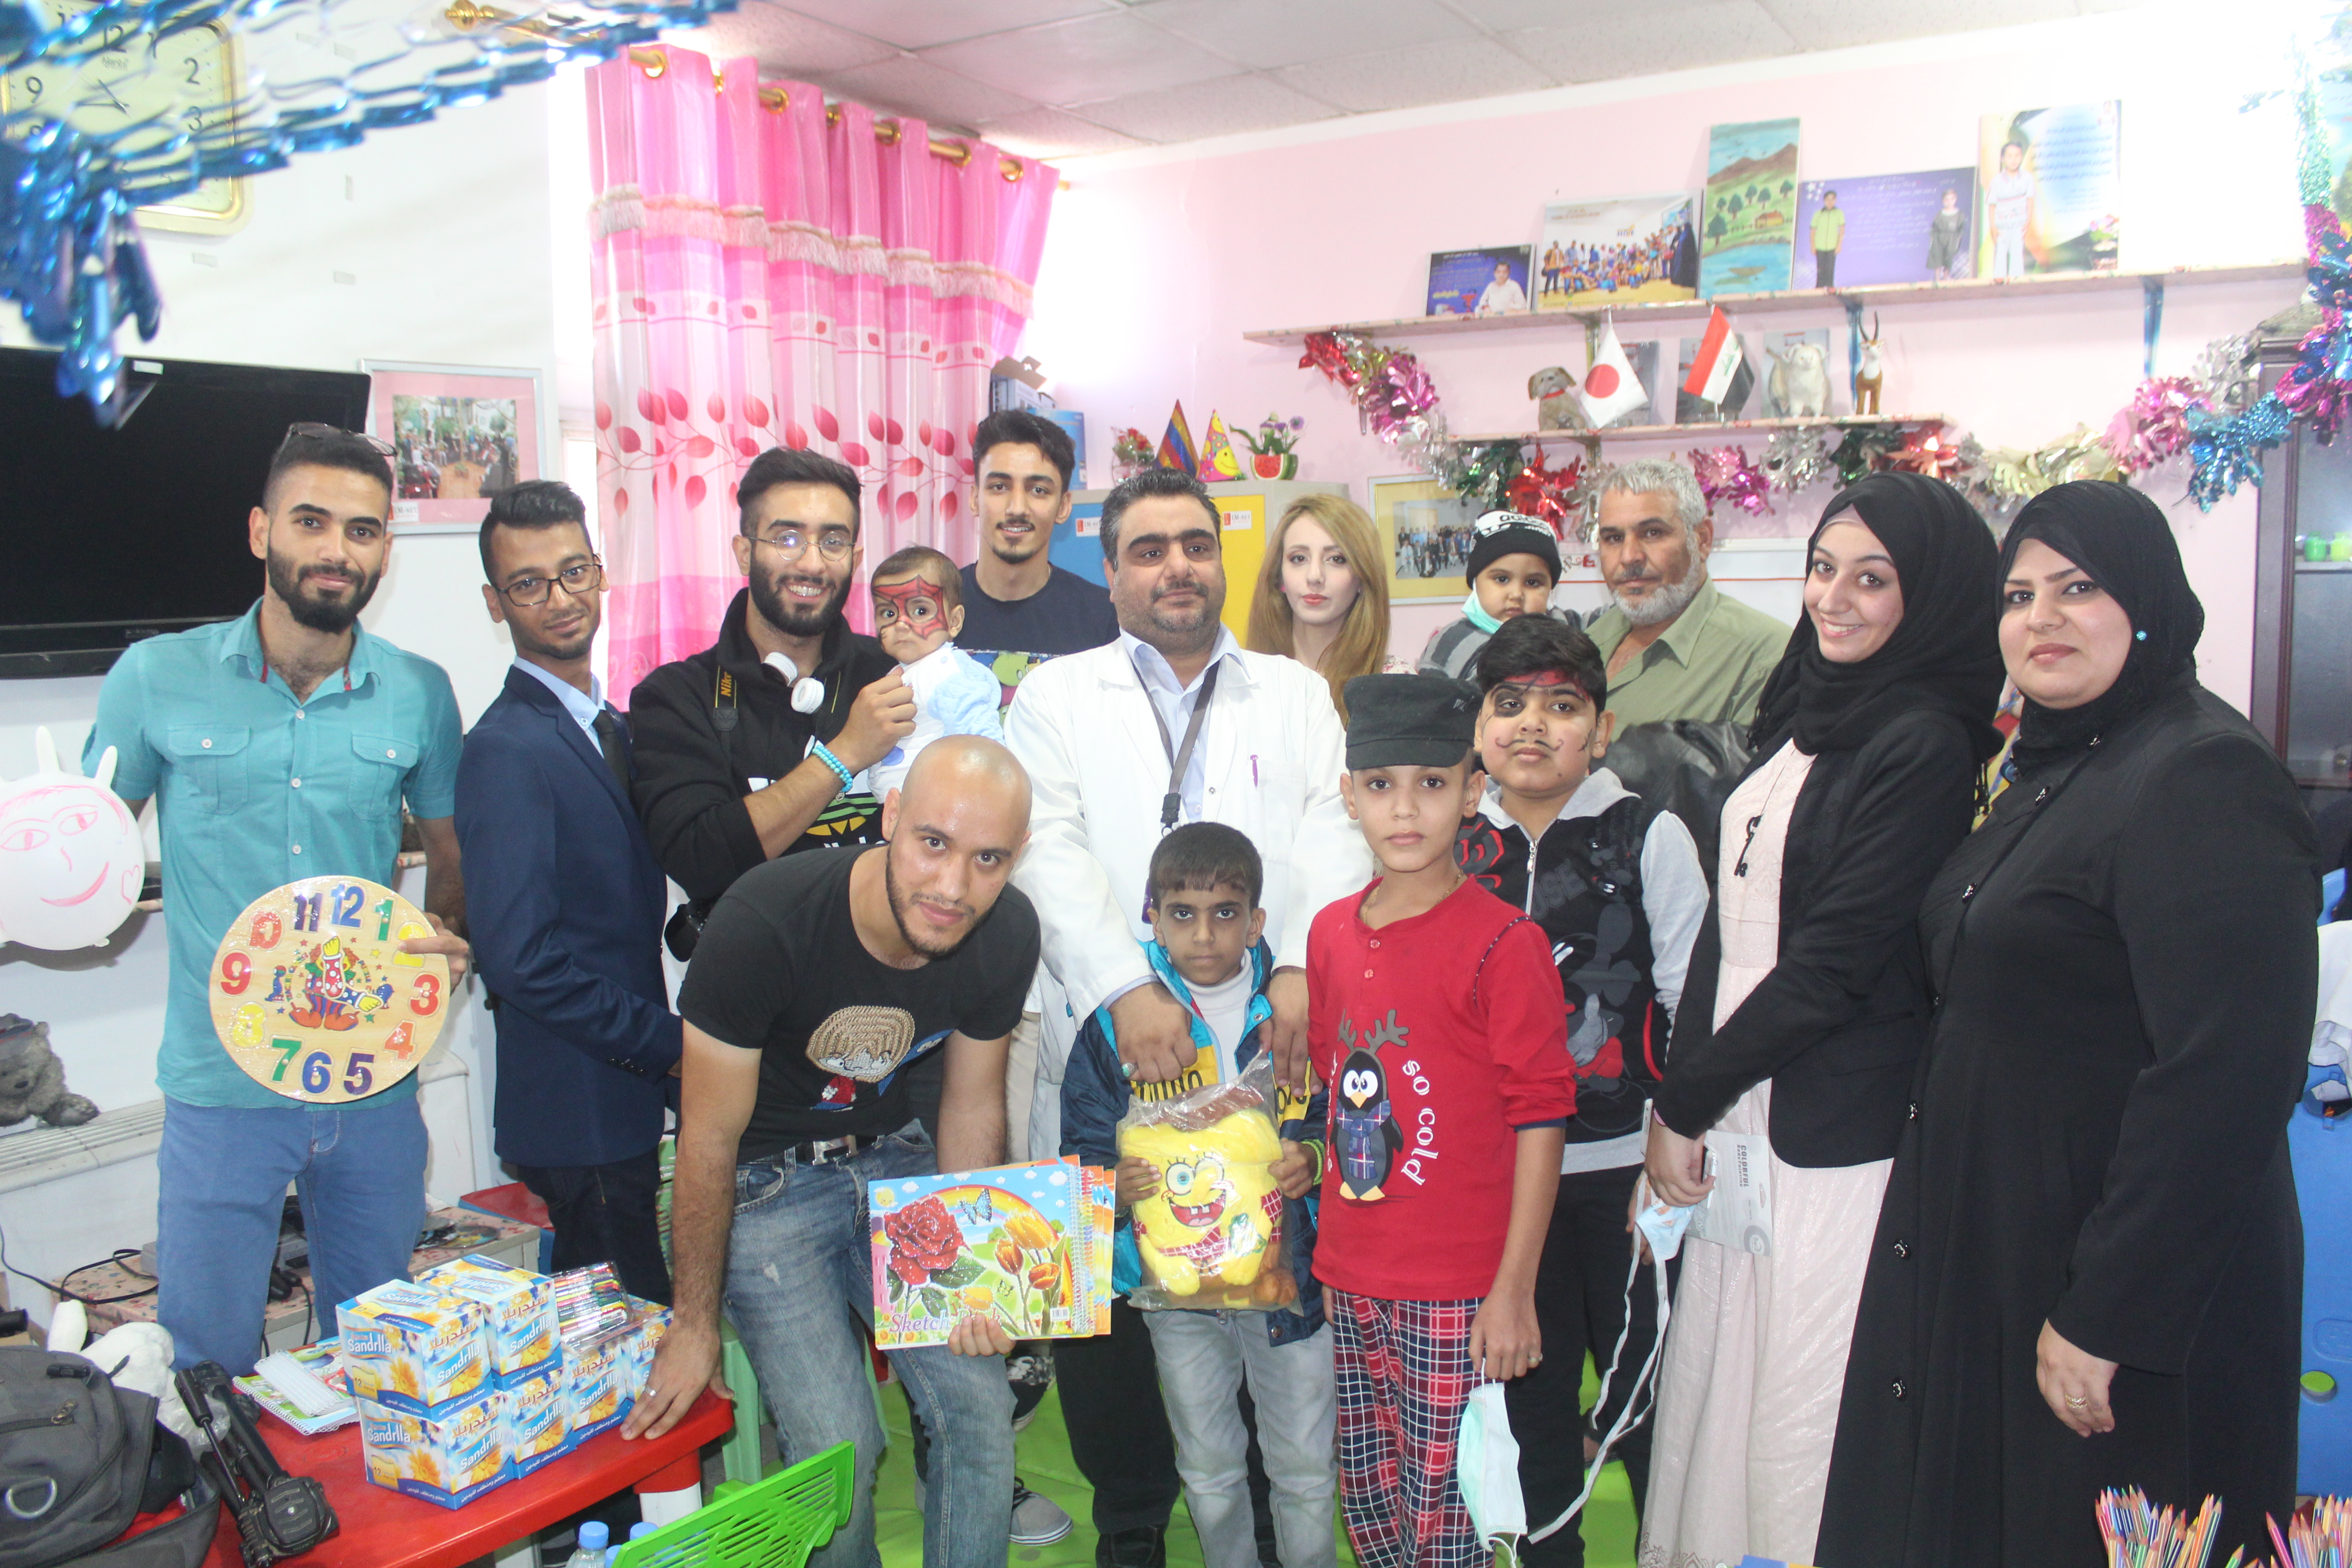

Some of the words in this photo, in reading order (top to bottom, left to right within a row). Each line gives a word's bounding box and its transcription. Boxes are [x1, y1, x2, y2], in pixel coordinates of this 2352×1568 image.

[26, 76, 43, 103] 9
[184, 58, 200, 85] 2
[188, 106, 202, 132] 3
[293, 892, 324, 933] 11
[330, 884, 365, 928] 12
[375, 899, 394, 941] 1
[220, 952, 252, 995] 9
[410, 974, 441, 1016] 3
[231, 1004, 266, 1048] 8
[384, 1021, 416, 1060] 4
[271, 1038, 303, 1082] 7
[302, 1052, 332, 1094] 6
[343, 1052, 376, 1095] 5
[1402, 1060, 1430, 1096] so
[1401, 1108, 1439, 1186] cold
[1741, 1145, 1749, 1187] COLORFUL
[501, 1294, 550, 1322] سندريلا
[890, 1309, 950, 1333] Sketch
[348, 1333, 392, 1354] Sandrlla
[428, 1322, 477, 1352] سندريلا
[510, 1316, 553, 1353] Sandrlla
[437, 1343, 481, 1383] Sandrlla
[572, 1352, 615, 1379] سندريلا
[516, 1380, 561, 1409] سندريلا
[579, 1373, 618, 1409] Sandrlla
[367, 1423, 412, 1444] Sandrlla
[452, 1408, 499, 1438] سندريلا
[524, 1402, 566, 1441] Sandrlla
[460, 1430, 502, 1470] Sandrlla
